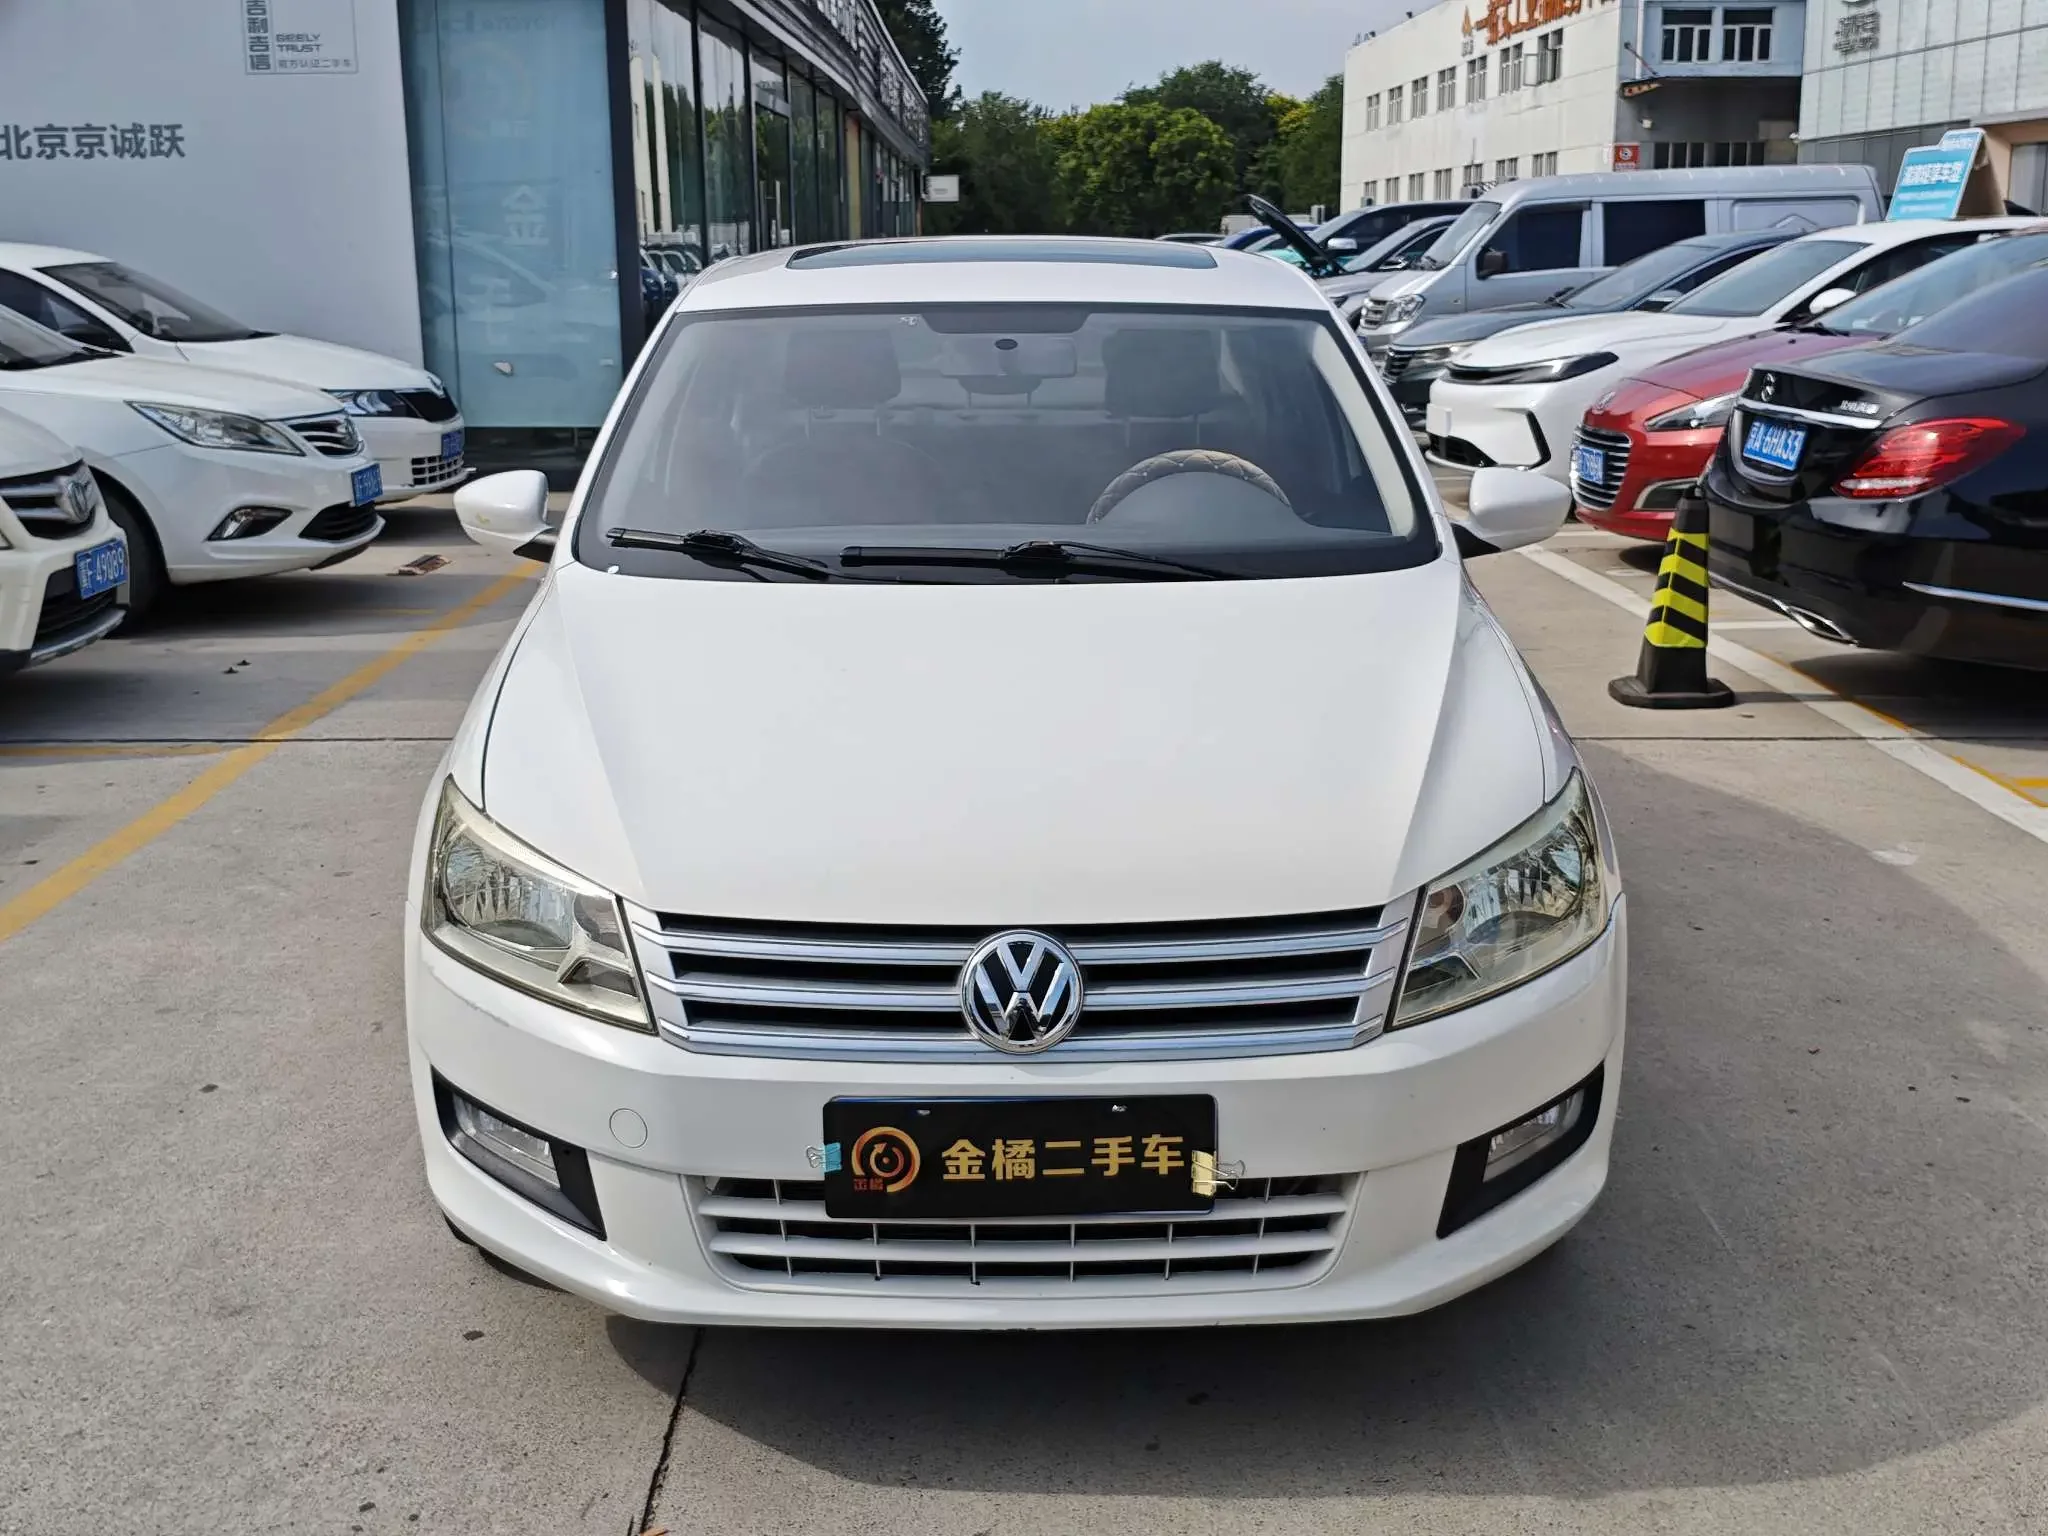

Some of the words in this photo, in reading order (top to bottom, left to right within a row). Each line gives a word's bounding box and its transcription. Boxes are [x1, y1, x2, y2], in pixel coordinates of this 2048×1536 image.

[276, 33, 320, 42] GEELY
[276, 44, 322, 52] TRUST
[0, 122, 186, 160] 北京京诚跃
[942, 1134, 1184, 1182] 金橘二手车
